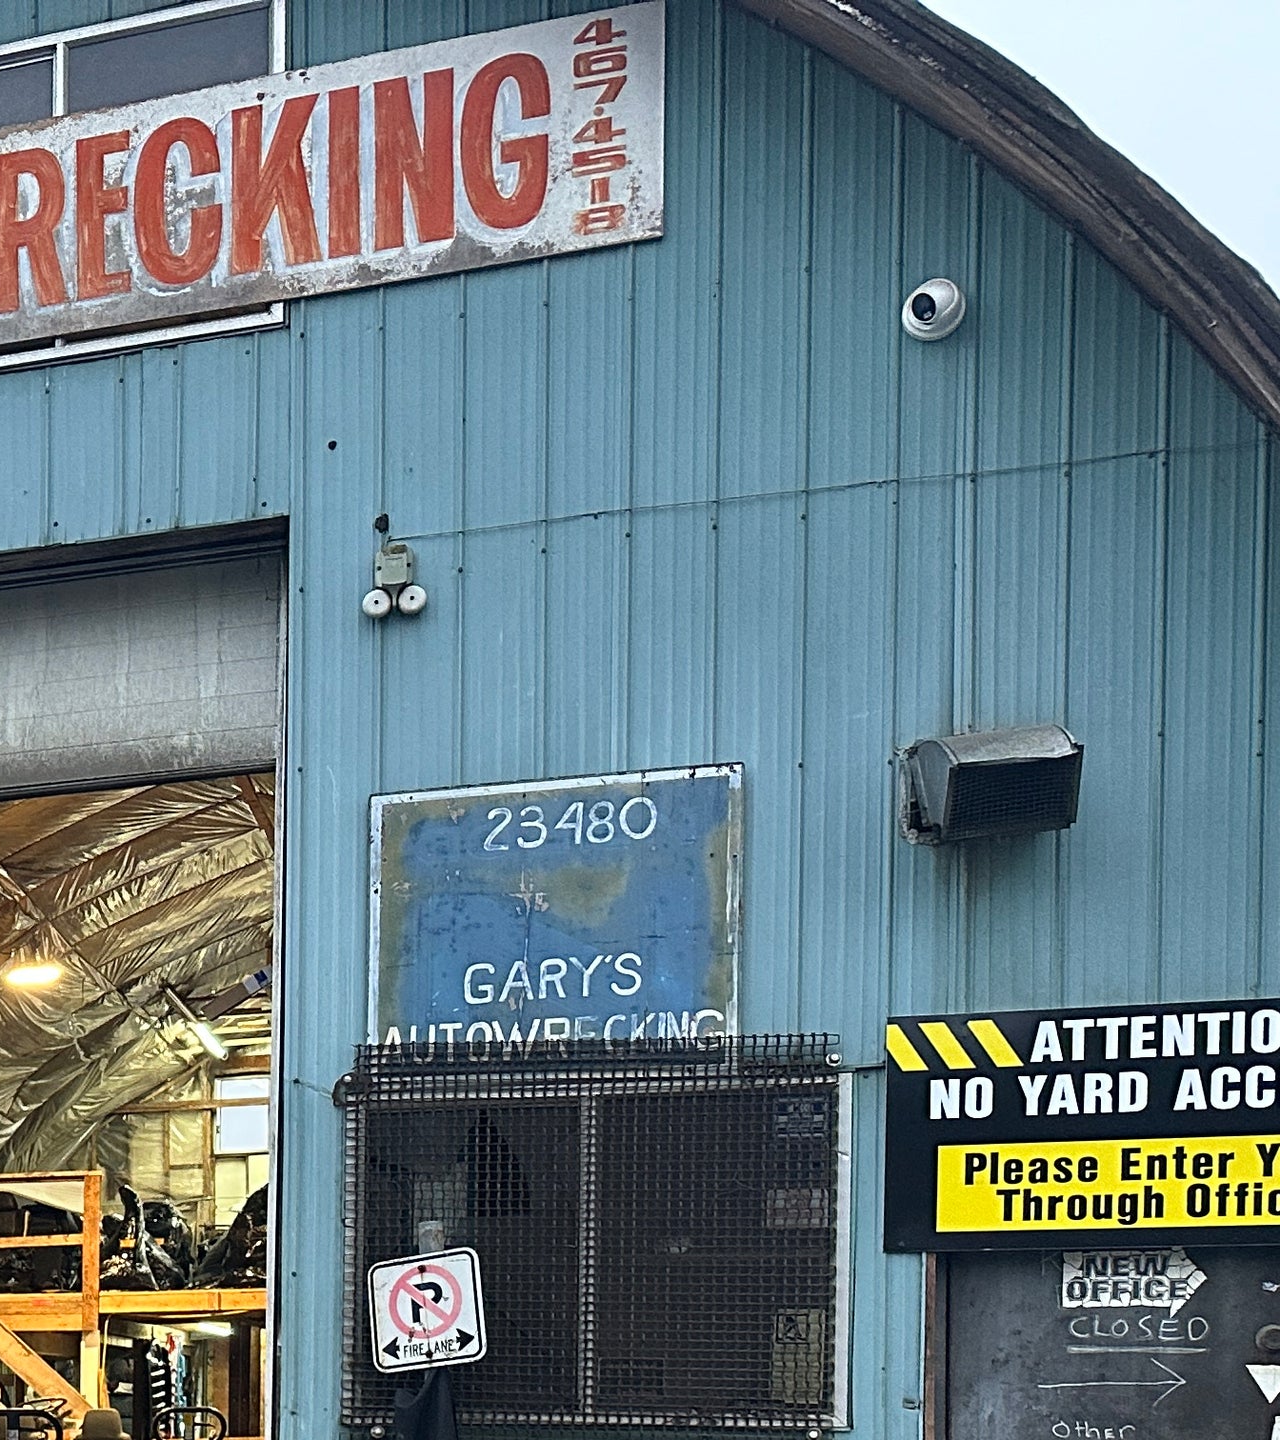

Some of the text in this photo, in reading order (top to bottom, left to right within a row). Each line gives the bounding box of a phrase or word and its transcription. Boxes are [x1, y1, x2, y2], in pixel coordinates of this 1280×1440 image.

[482, 796, 658, 851] 23480
[462, 952, 643, 1006] GARY'S
[1029, 1008, 1280, 1064] ATTENTIO
[928, 1064, 1277, 1121] NO YARD ACC
[963, 1143, 1280, 1186] Please Enter Y
[995, 1185, 1165, 1226] Through
[1083, 1253, 1171, 1278] NEW
[1065, 1278, 1189, 1301] OFFICE
[403, 1338, 457, 1358] FIRE LANE
[1069, 1314, 1209, 1342] CLOSED
